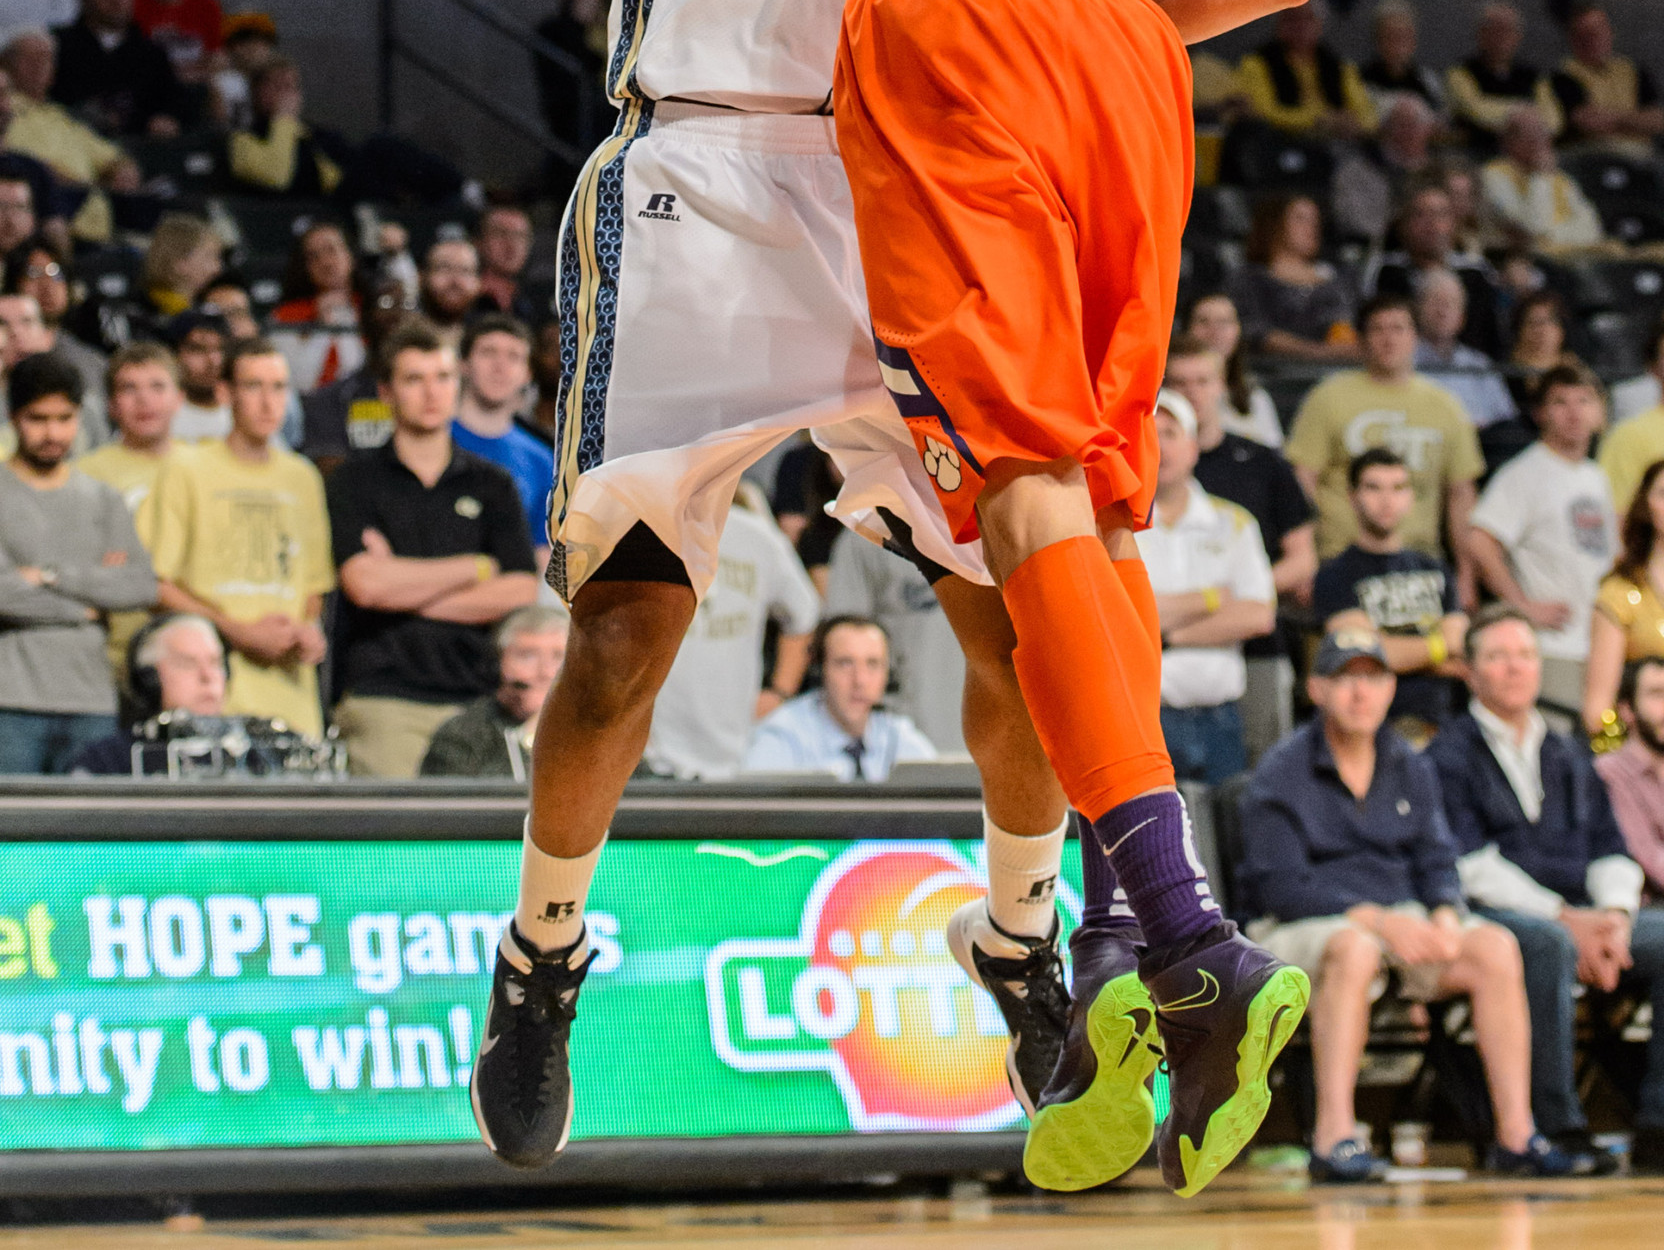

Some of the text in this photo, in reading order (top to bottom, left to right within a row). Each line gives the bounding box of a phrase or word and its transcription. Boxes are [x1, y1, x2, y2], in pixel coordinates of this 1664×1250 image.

[637, 210, 681, 222] RUSSELL
[646, 193, 677, 213] R
[0, 893, 625, 994] et HOPE gams
[738, 964, 1011, 1041] LOTT
[0, 1005, 473, 1114] nity to win!
